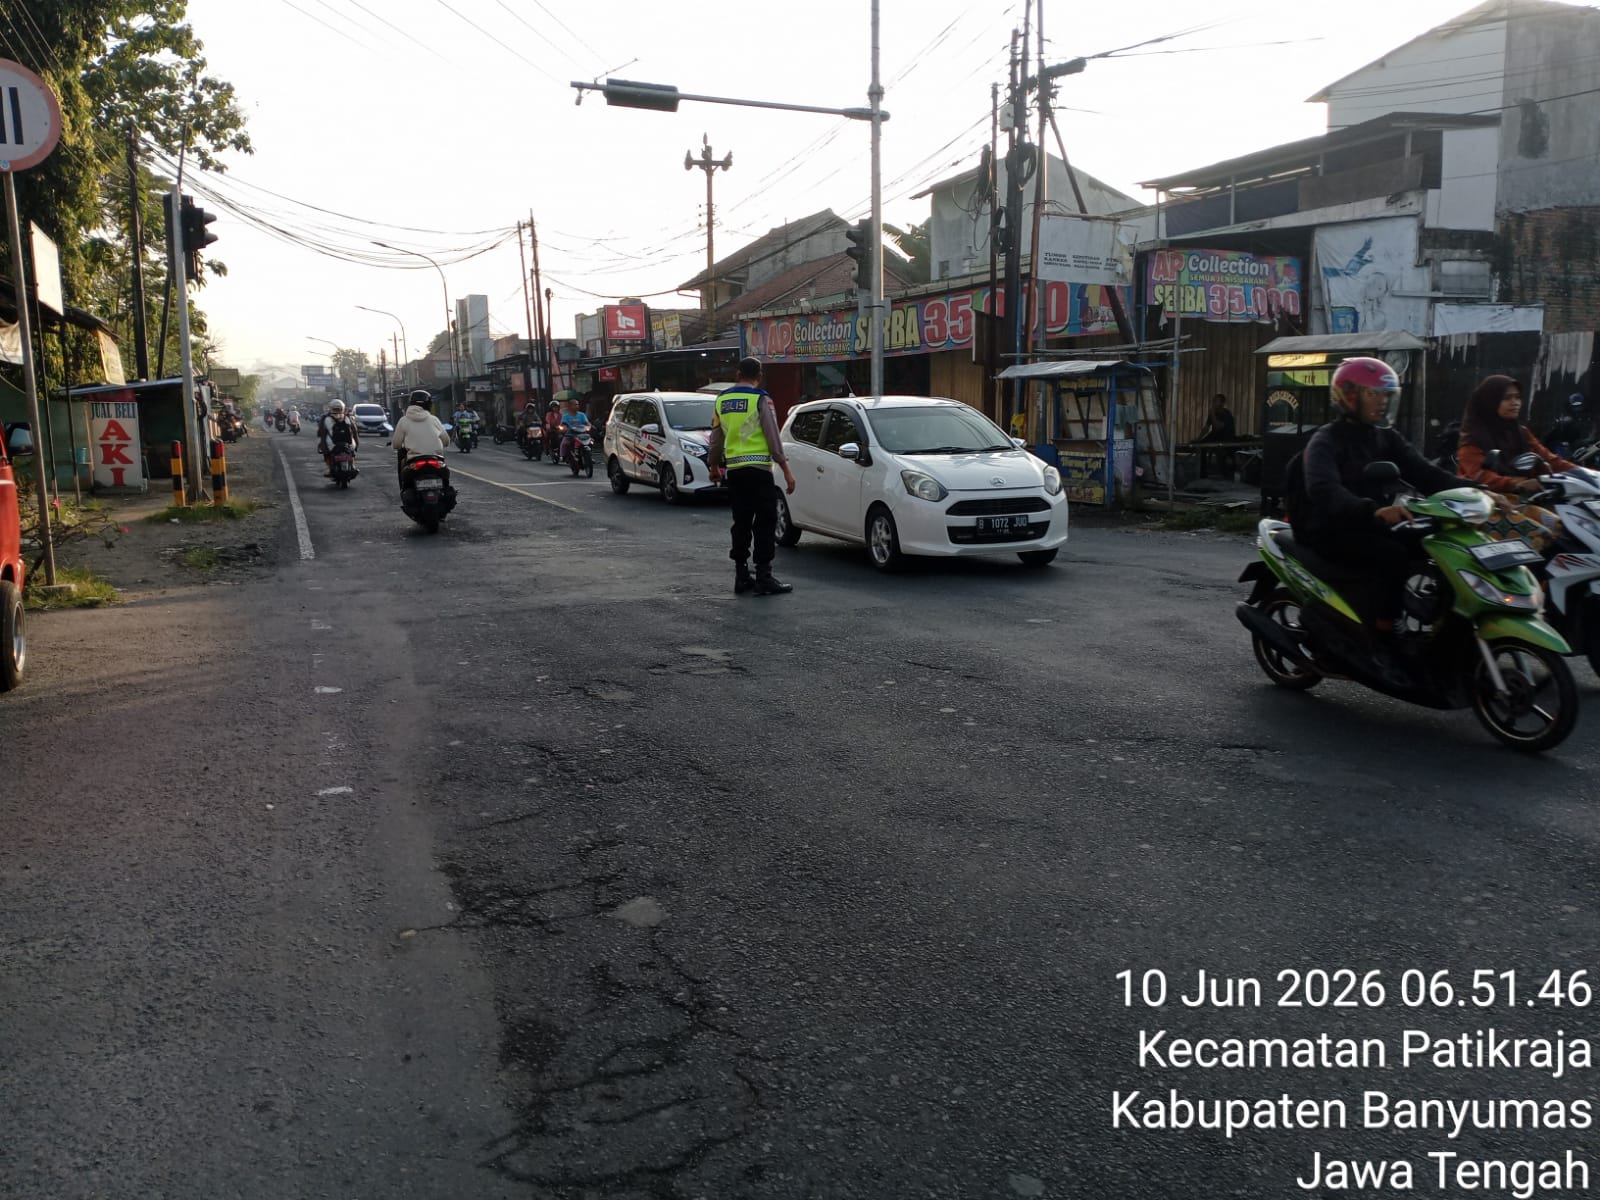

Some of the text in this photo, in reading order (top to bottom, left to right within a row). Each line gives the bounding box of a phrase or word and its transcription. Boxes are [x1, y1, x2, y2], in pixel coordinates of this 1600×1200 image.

[1152, 251, 1184, 281] AP
[1188, 254, 1269, 276] Collection
[767, 322, 792, 358] AP
[793, 319, 852, 342] Collection
[91, 403, 136, 420] JUAL BELI
[721, 400, 747, 411] POLISI
[99, 420, 133, 487] AKI
[992, 518, 1009, 529] 1072
